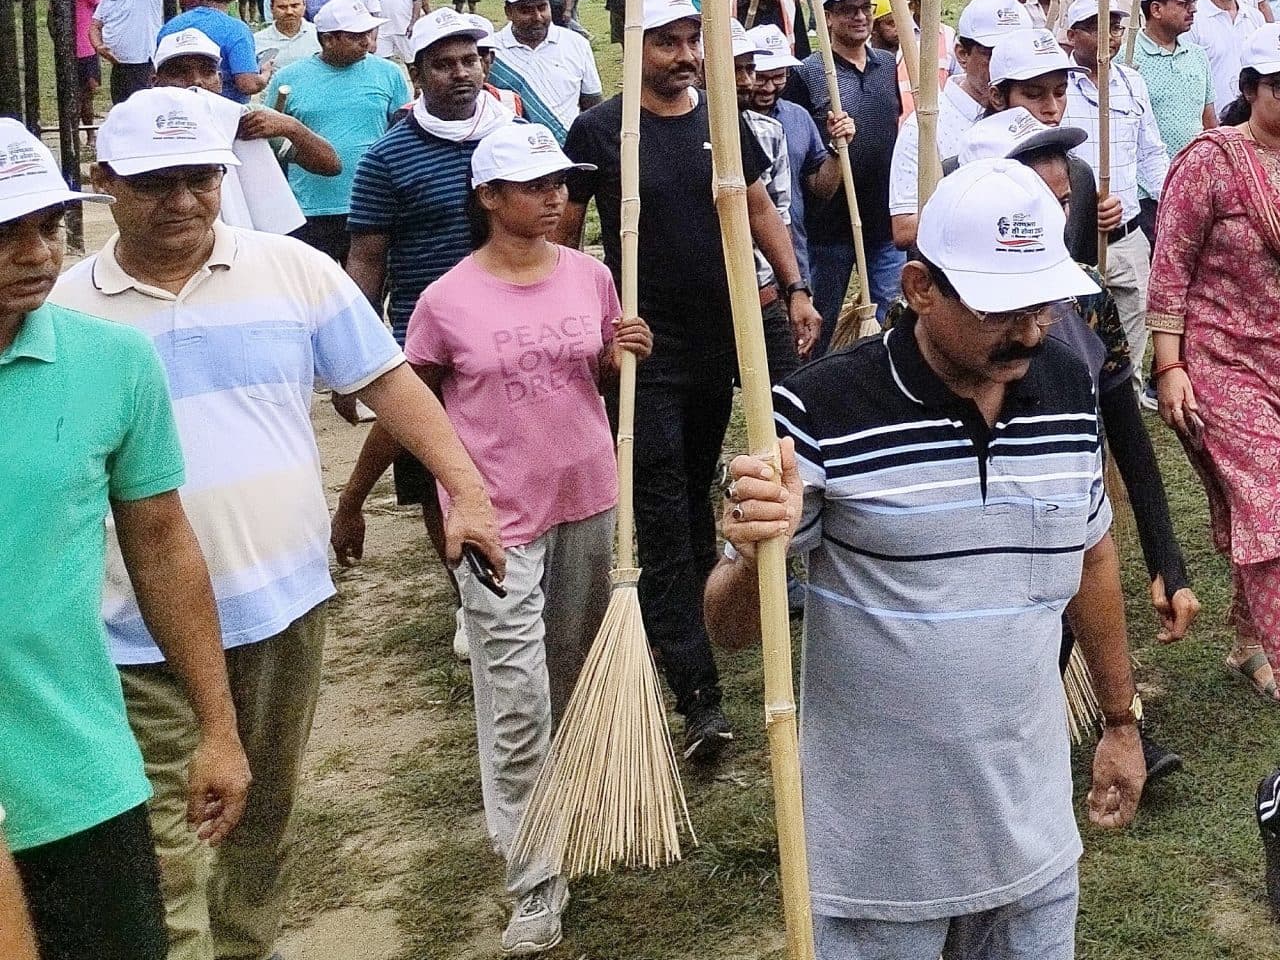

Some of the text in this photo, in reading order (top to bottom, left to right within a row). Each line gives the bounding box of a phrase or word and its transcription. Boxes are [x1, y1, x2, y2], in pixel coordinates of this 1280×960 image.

[493, 314, 594, 354] PEACE
[499, 341, 585, 379] LOVE
[504, 365, 586, 401] DREA
